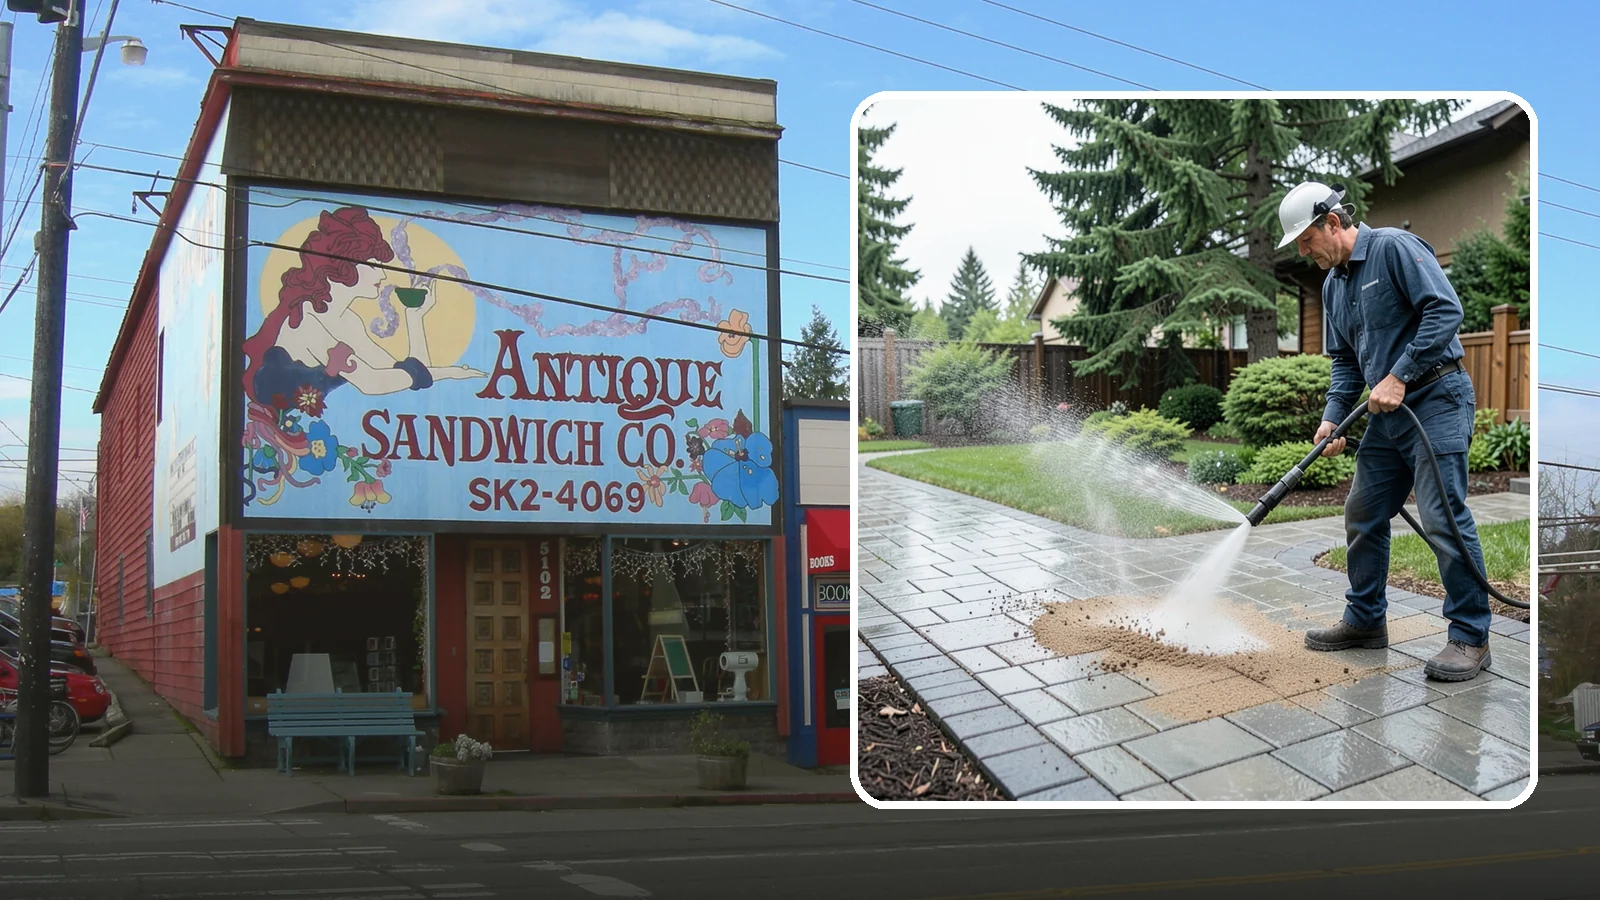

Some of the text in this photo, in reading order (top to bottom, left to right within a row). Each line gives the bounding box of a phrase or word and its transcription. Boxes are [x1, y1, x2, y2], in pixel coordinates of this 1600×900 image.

[476, 329, 723, 421] ANTIQUE
[361, 408, 685, 468] SANDWICH CO.
[468, 477, 645, 513] SK2-4069
[540, 541, 551, 600] 5102
[809, 555, 834, 569] BOOKS
